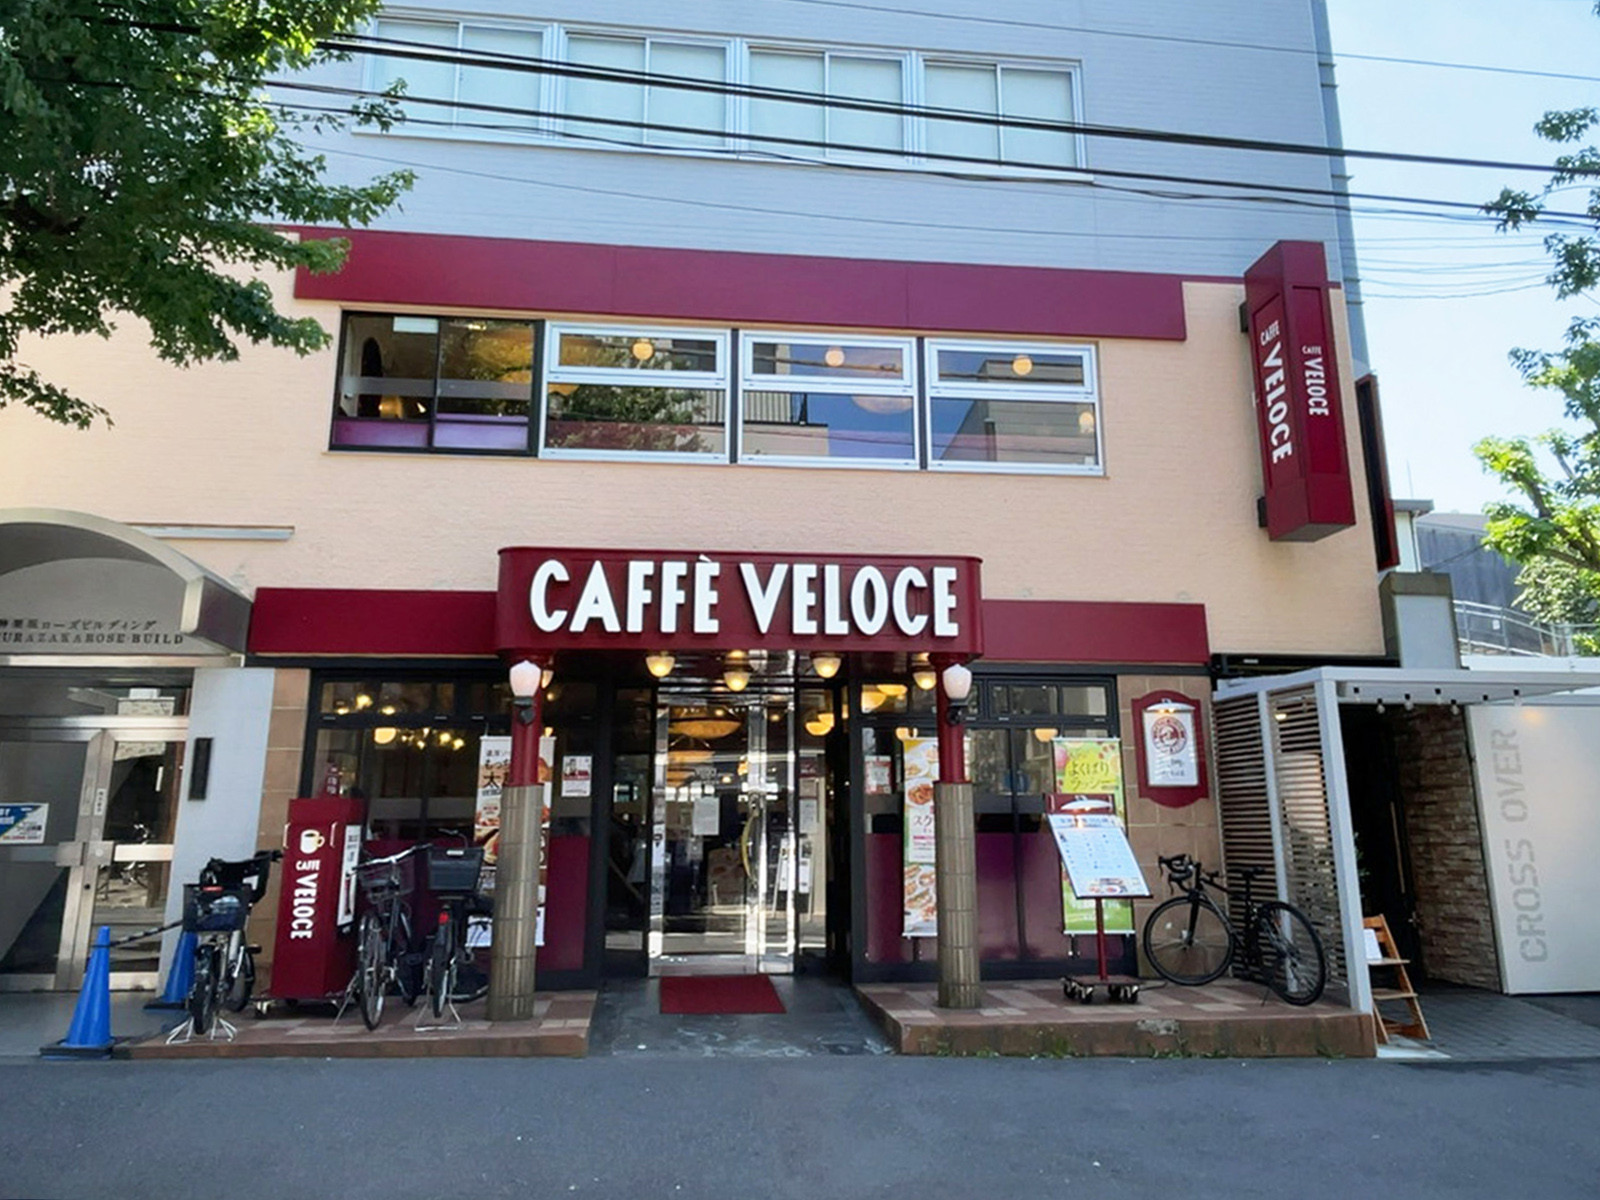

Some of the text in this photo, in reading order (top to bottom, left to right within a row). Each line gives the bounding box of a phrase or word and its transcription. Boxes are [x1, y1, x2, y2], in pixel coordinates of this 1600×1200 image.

[1263, 342, 1292, 464] VELOCE
[1303, 357, 1329, 417] VELOCE
[529, 554, 960, 638] CAFFÈ VELOCE
[1490, 728, 1548, 964] CROSS OVER
[290, 872, 319, 939] VELOCE
